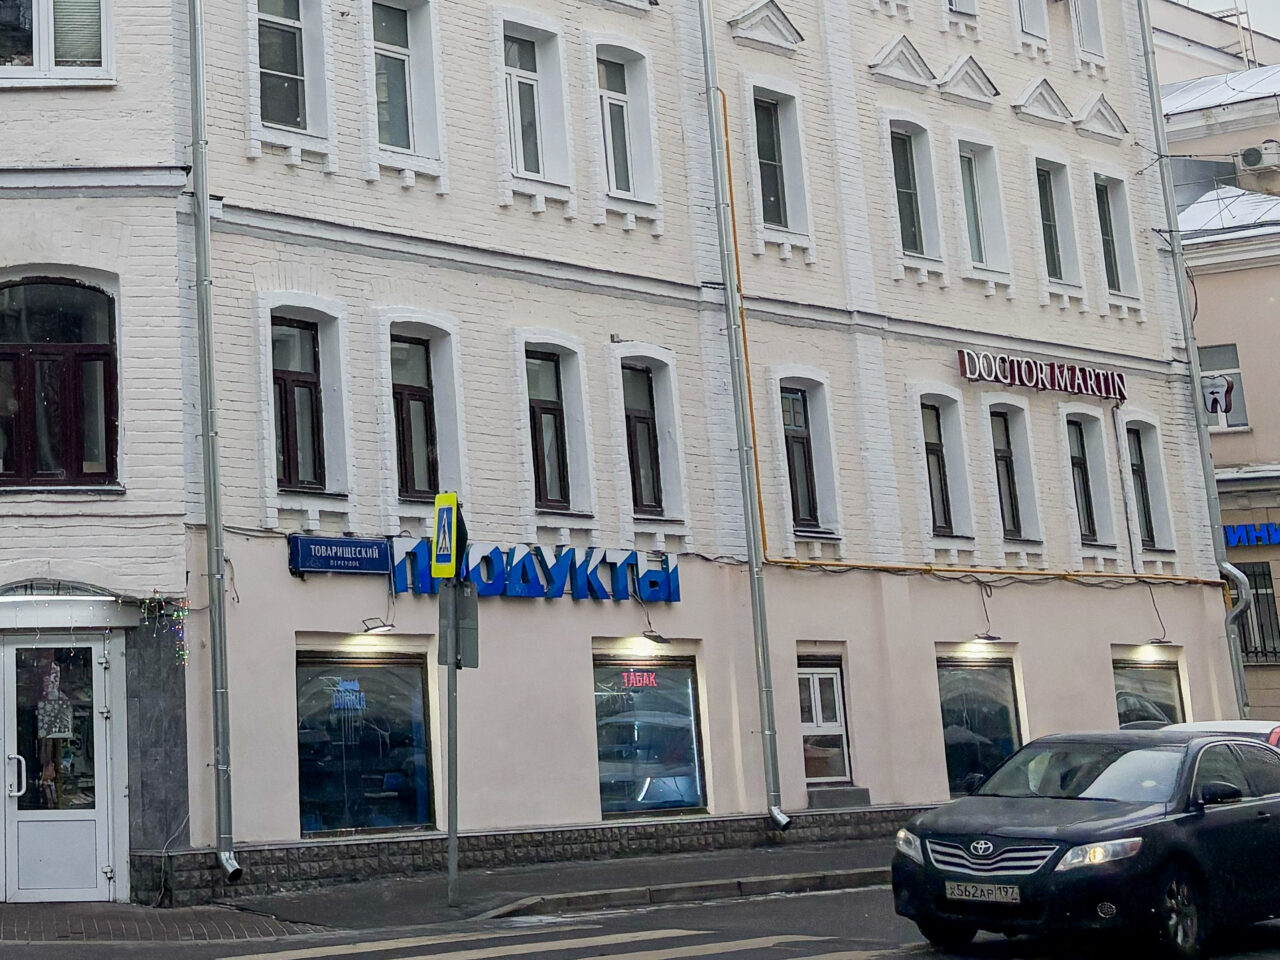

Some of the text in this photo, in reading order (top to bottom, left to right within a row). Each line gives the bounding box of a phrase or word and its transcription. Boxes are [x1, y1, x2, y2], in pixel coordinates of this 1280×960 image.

[960, 349, 1127, 400] DOCTOR MARTIN
[310, 544, 379, 559] ТОВАРИЩЕСКИЙ
[329, 559, 360, 567] ПЕРЕУЛОК
[394, 537, 681, 603] ПОДУКТЫ
[621, 672, 657, 687] ТАБАК
[997, 886, 1016, 897] 197
